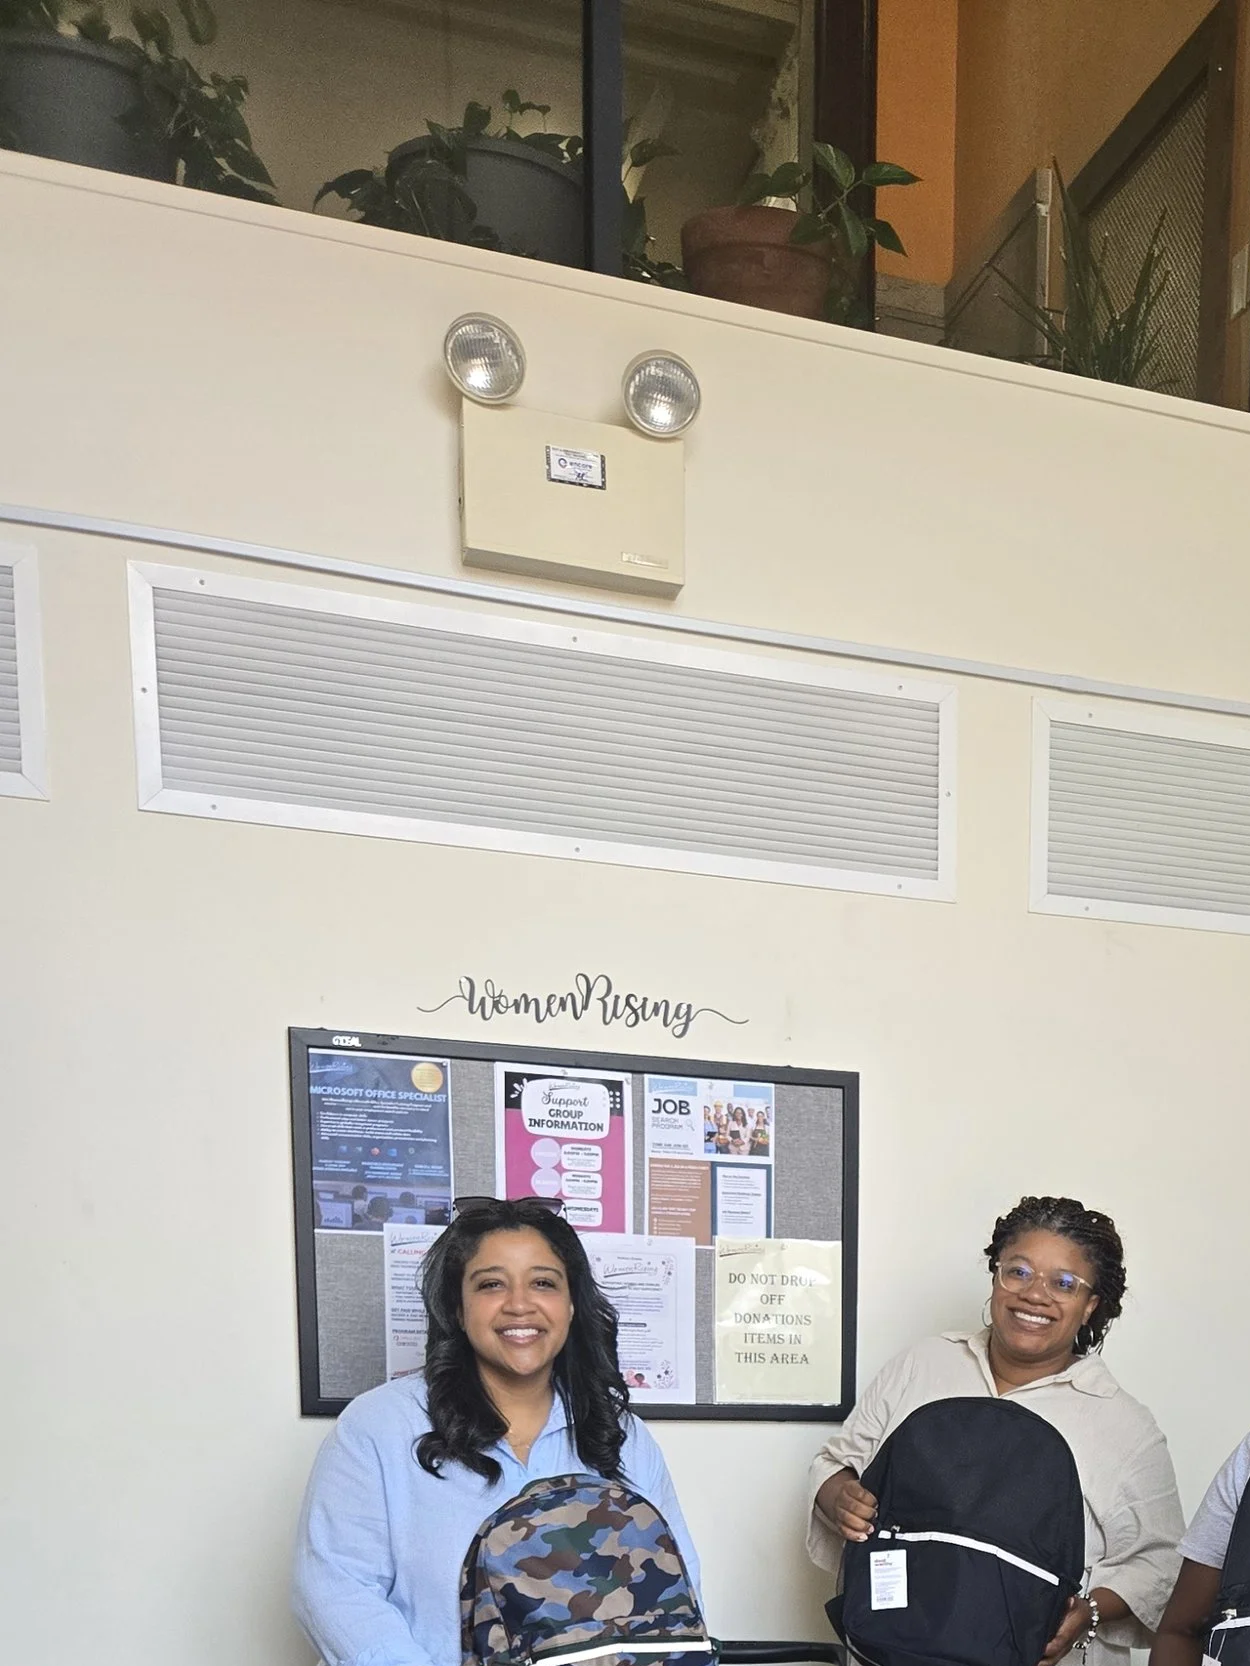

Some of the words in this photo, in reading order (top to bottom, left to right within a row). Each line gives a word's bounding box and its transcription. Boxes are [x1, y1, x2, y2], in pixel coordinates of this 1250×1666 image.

[417, 973, 749, 1039] WomenRising
[310, 1086, 363, 1097] MICROSOFT
[365, 1089, 397, 1099] OFFICE
[398, 1092, 447, 1103] SPECIALIST
[541, 1091, 589, 1108] Support
[549, 1108, 583, 1119] GROUP
[652, 1098, 691, 1115] JOB
[528, 1118, 604, 1132] INFORMATION
[728, 1272, 746, 1284] DO
[751, 1273, 777, 1285] NOT
[760, 1294, 785, 1305] OFF
[734, 1312, 812, 1326] DONATIONS
[744, 1332, 785, 1344] ITEMS
[789, 1334, 802, 1345] IN
[735, 1352, 766, 1364] THIS
[770, 1353, 810, 1364] AREA
